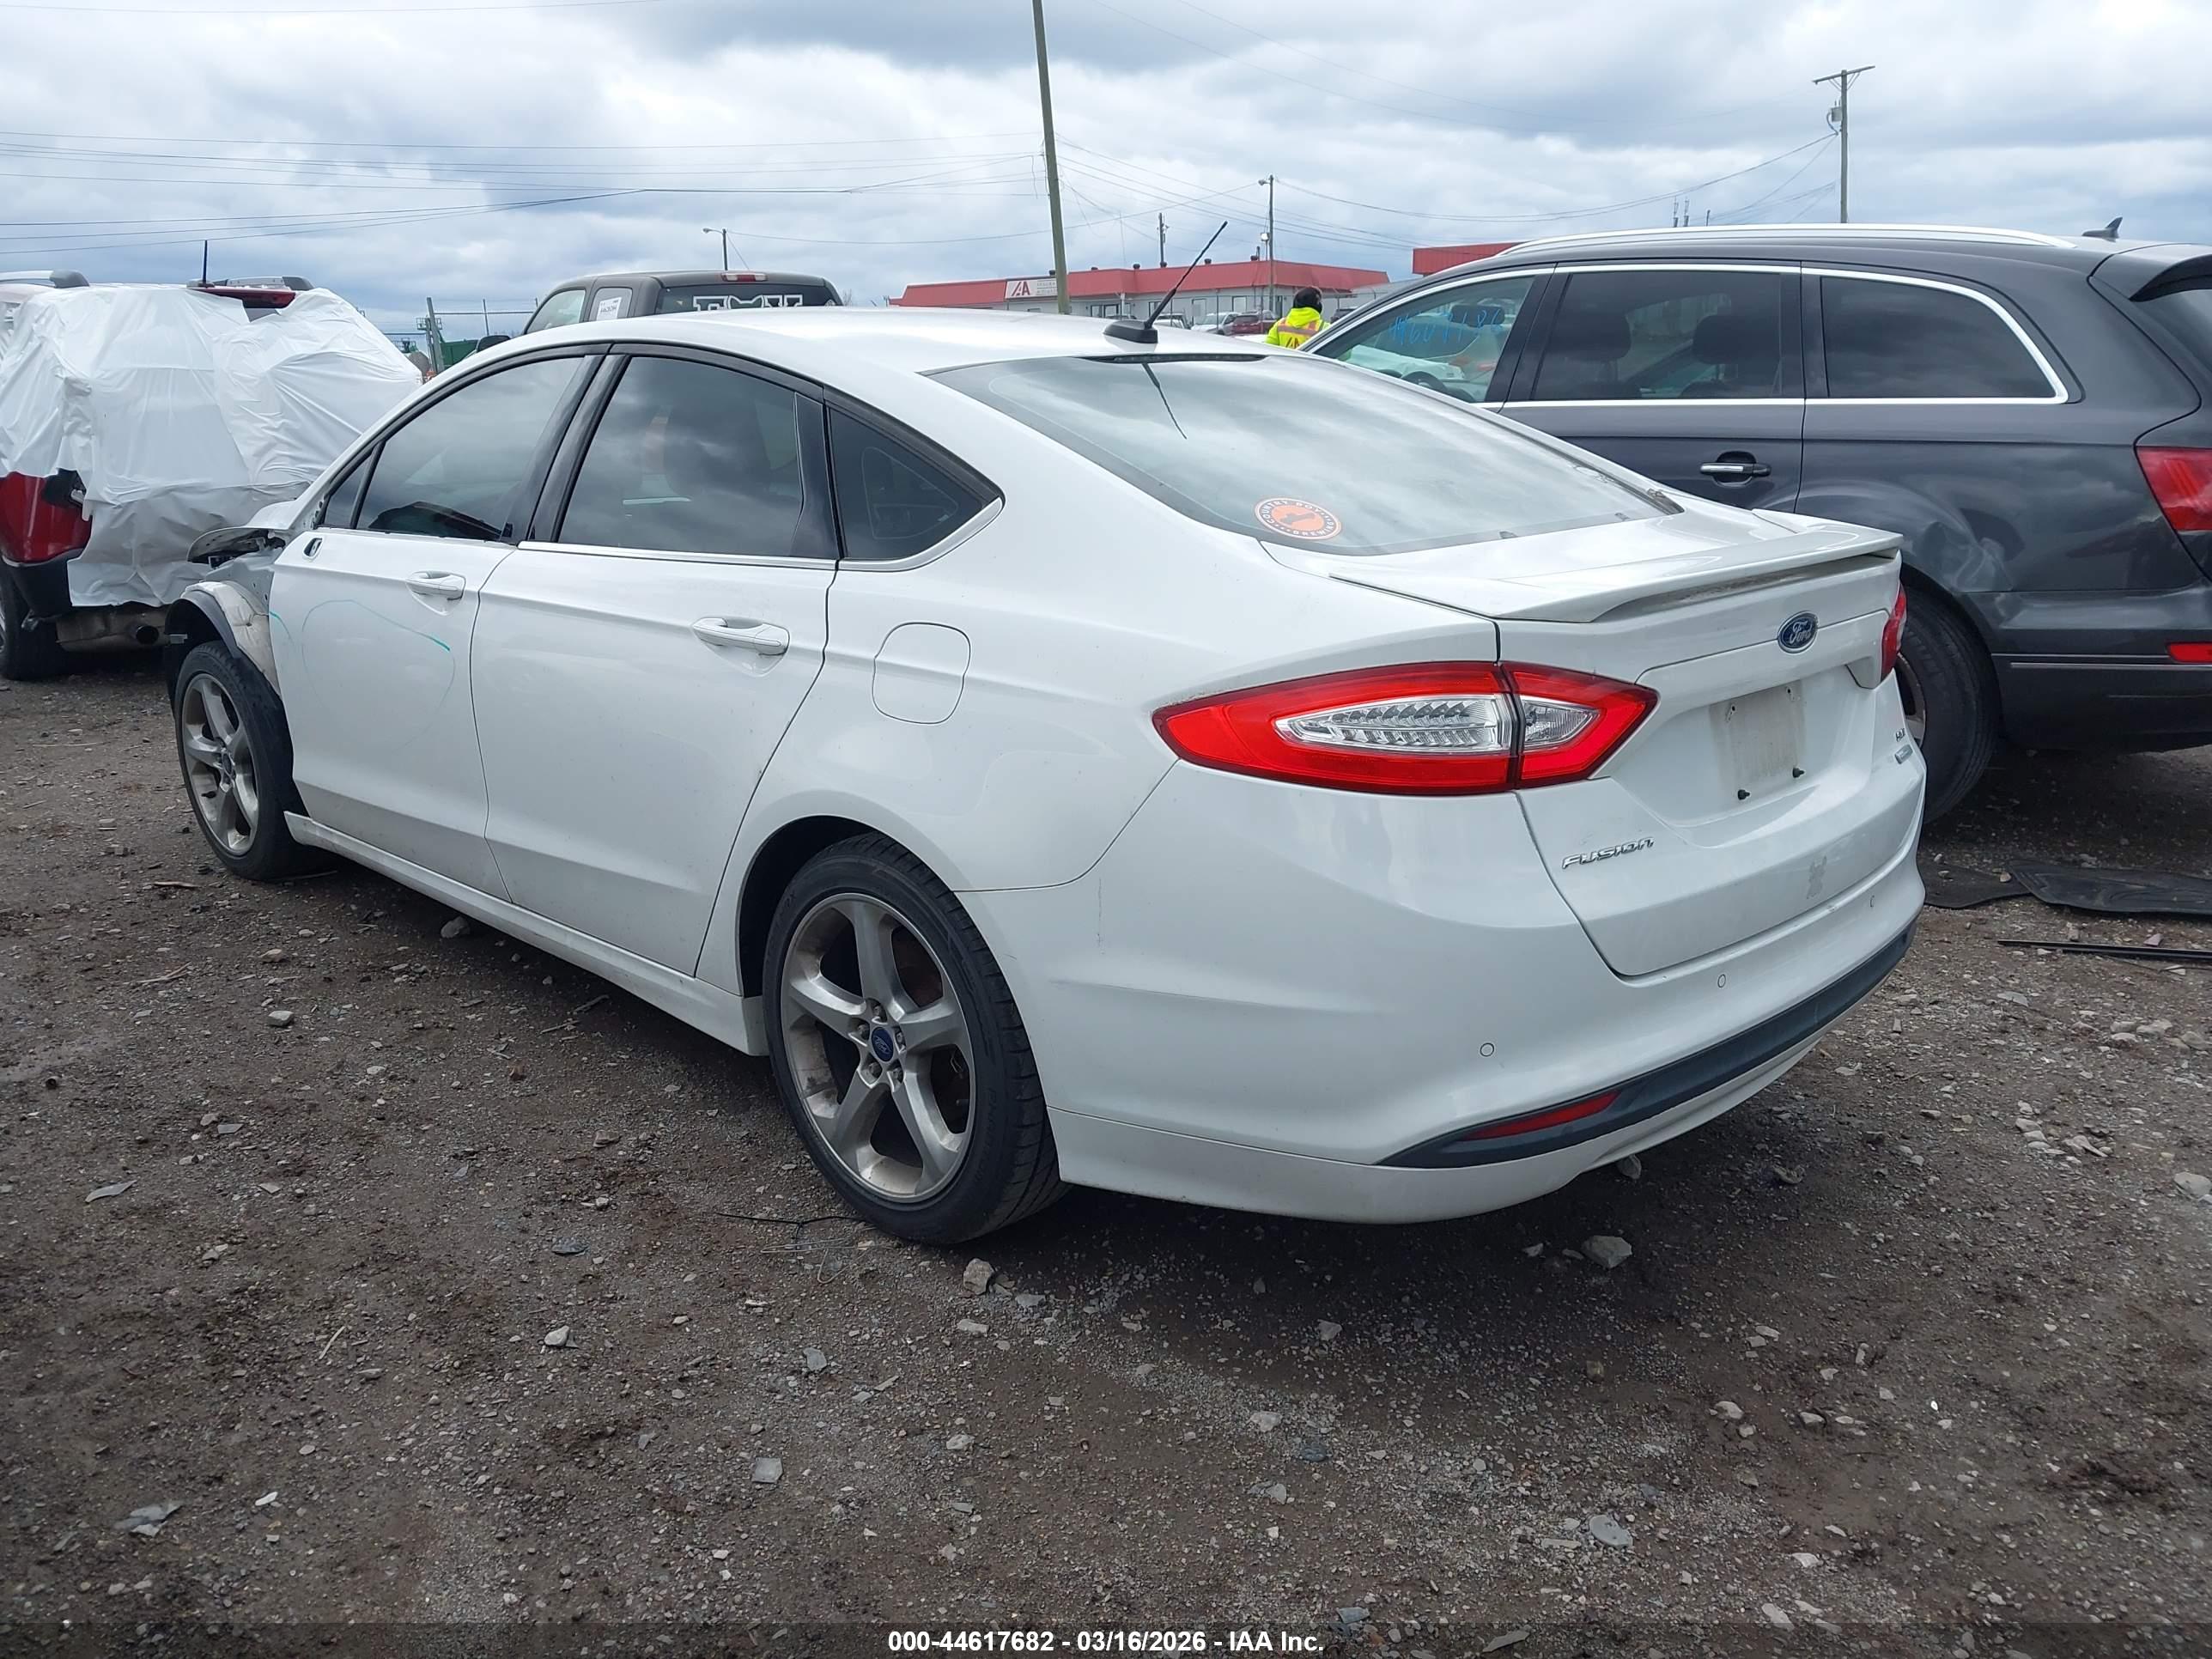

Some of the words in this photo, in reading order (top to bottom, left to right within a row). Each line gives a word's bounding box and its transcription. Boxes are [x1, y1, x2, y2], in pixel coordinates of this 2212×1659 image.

[1261, 501, 1288, 524] COUNTRY
[1296, 501, 1322, 513] BOY
[1291, 519, 1334, 537] BREWING
[1789, 619, 1813, 644] Ford
